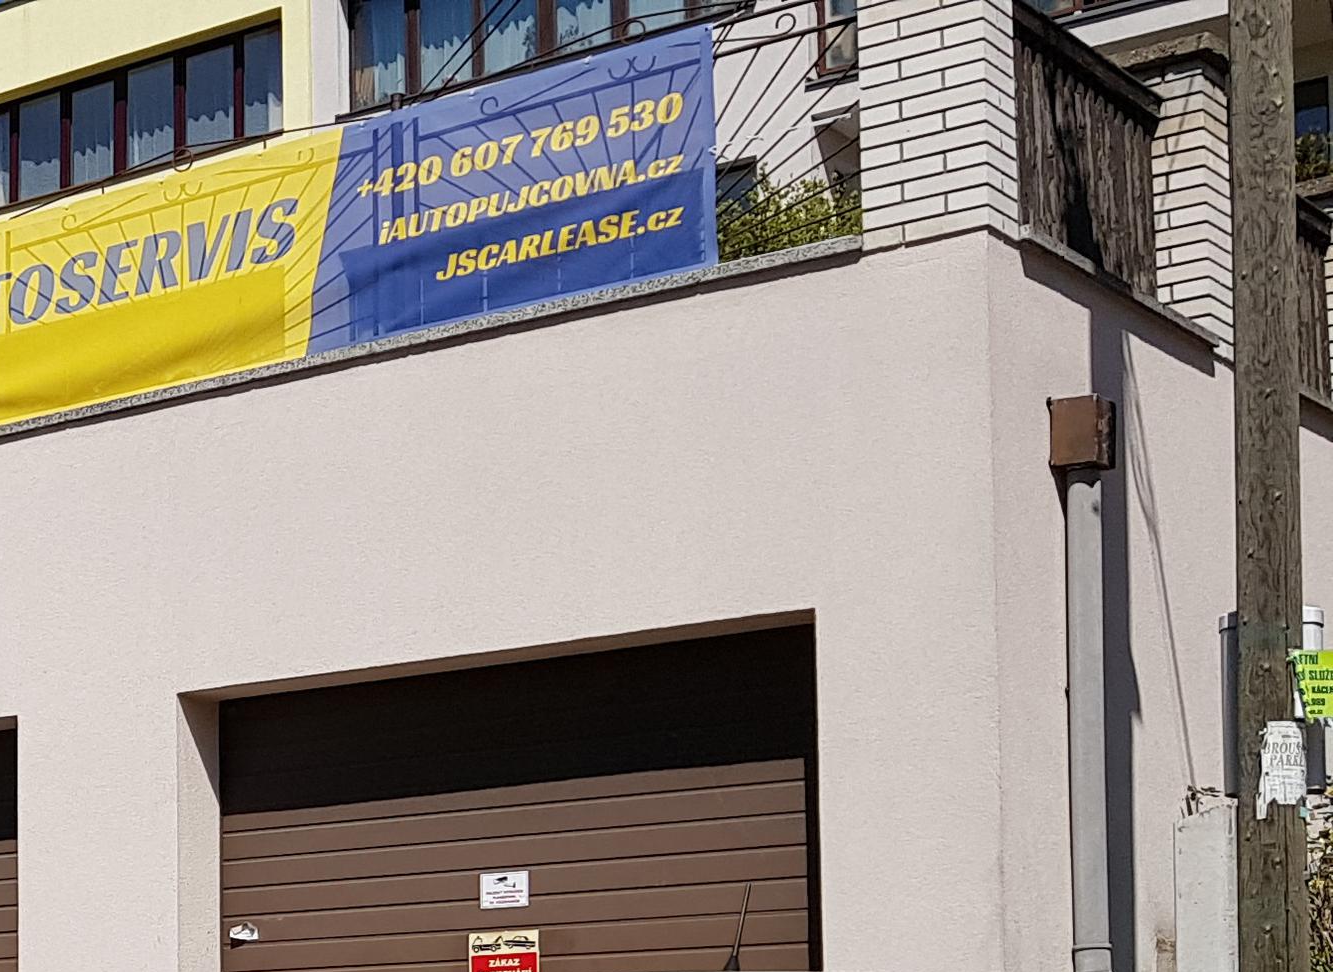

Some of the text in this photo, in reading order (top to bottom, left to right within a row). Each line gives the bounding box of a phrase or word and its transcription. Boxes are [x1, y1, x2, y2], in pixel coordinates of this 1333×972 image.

[356, 91, 685, 199] +420 607 769 530
[377, 153, 686, 246] iAUTOPUJCOVNA.cz
[435, 206, 686, 282] JSCARLEASE.cz
[488, 957, 520, 968] ZÁKAZ
